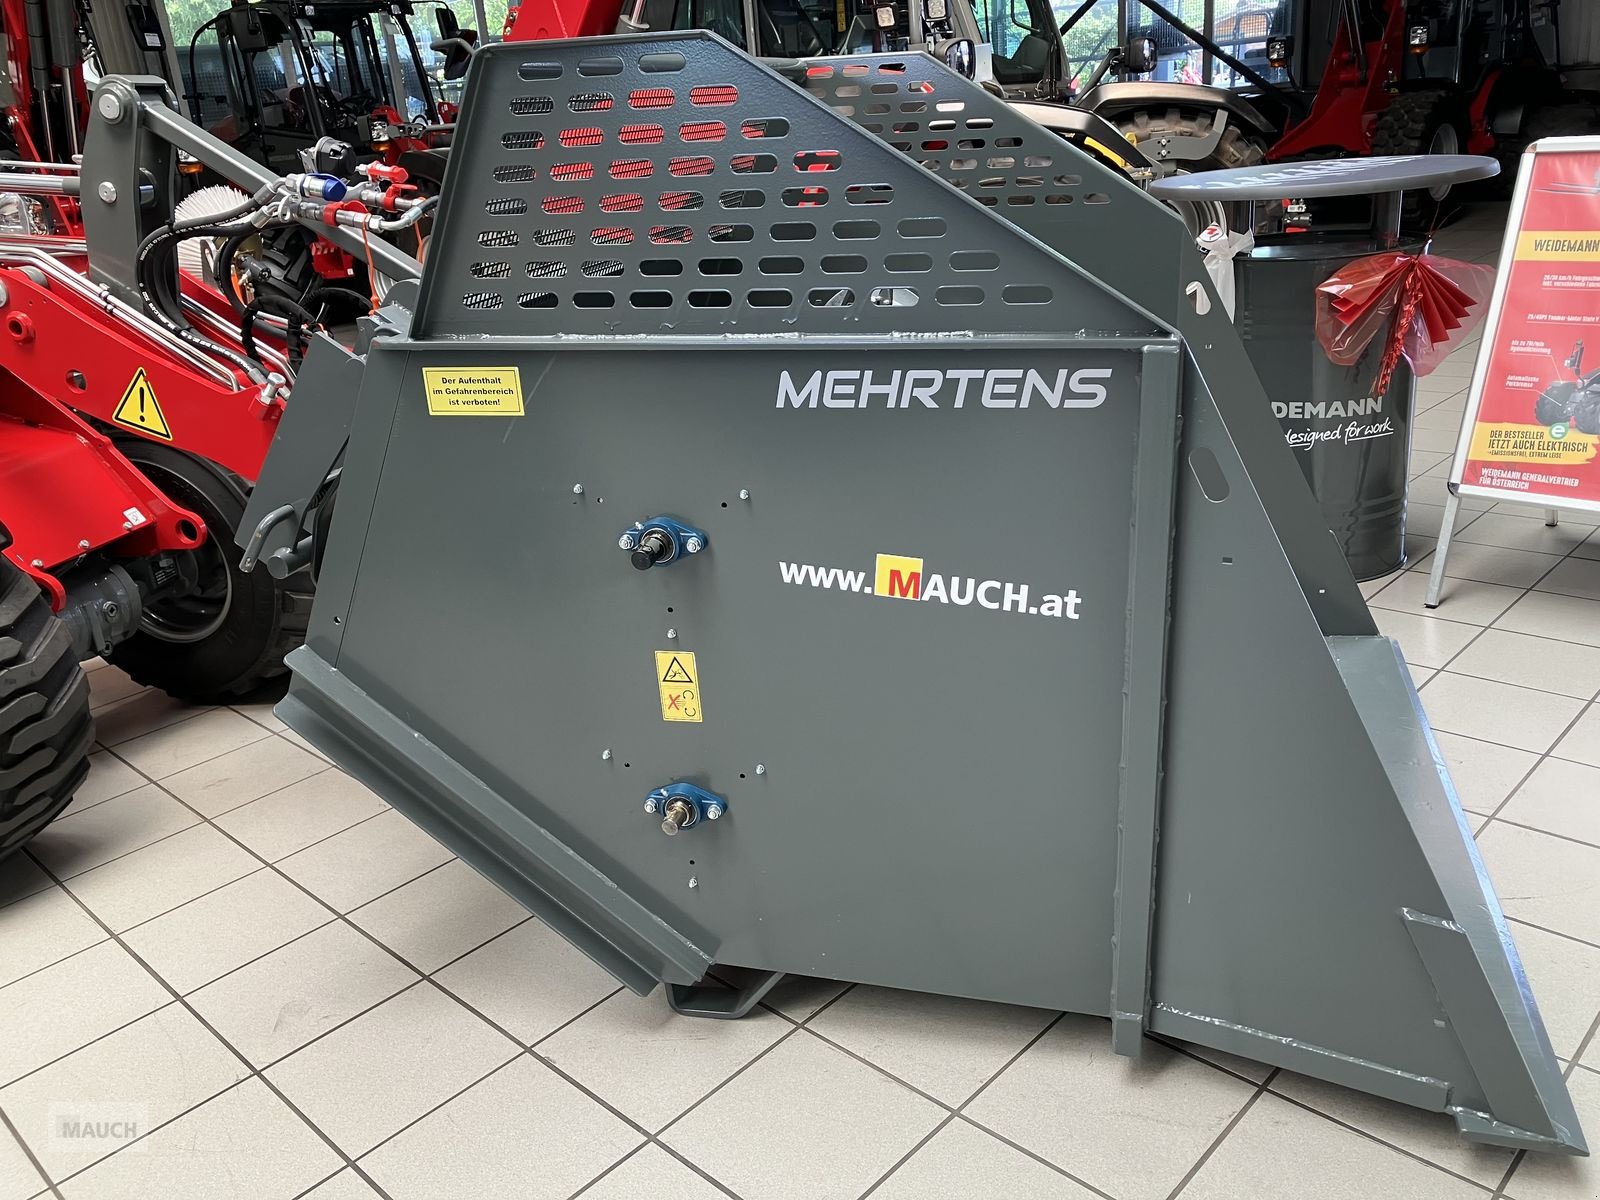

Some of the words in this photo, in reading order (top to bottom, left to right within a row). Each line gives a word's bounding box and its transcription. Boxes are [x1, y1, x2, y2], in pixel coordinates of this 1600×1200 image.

[1534, 239, 1600, 252] WEIDEMANN
[458, 377, 502, 385] Aufenthalt
[775, 368, 1112, 409] MEHRTENS
[1344, 421, 1366, 445] for
[1364, 417, 1395, 435] work
[1490, 430, 1503, 439] DER
[1504, 431, 1545, 440] BESTSELLER
[1488, 439, 1512, 449] JETZT
[1512, 440, 1538, 451] AUCH
[1538, 440, 1589, 453] ELEKTRISCH
[1479, 474, 1492, 485] FÜR
[1492, 477, 1530, 490] ÖSTERREICH
[1481, 467, 1522, 480] WEIDEMANN
[1521, 472, 1580, 487] GENERALVERTRIEB
[778, 560, 1082, 620] www.MAUCH.at
